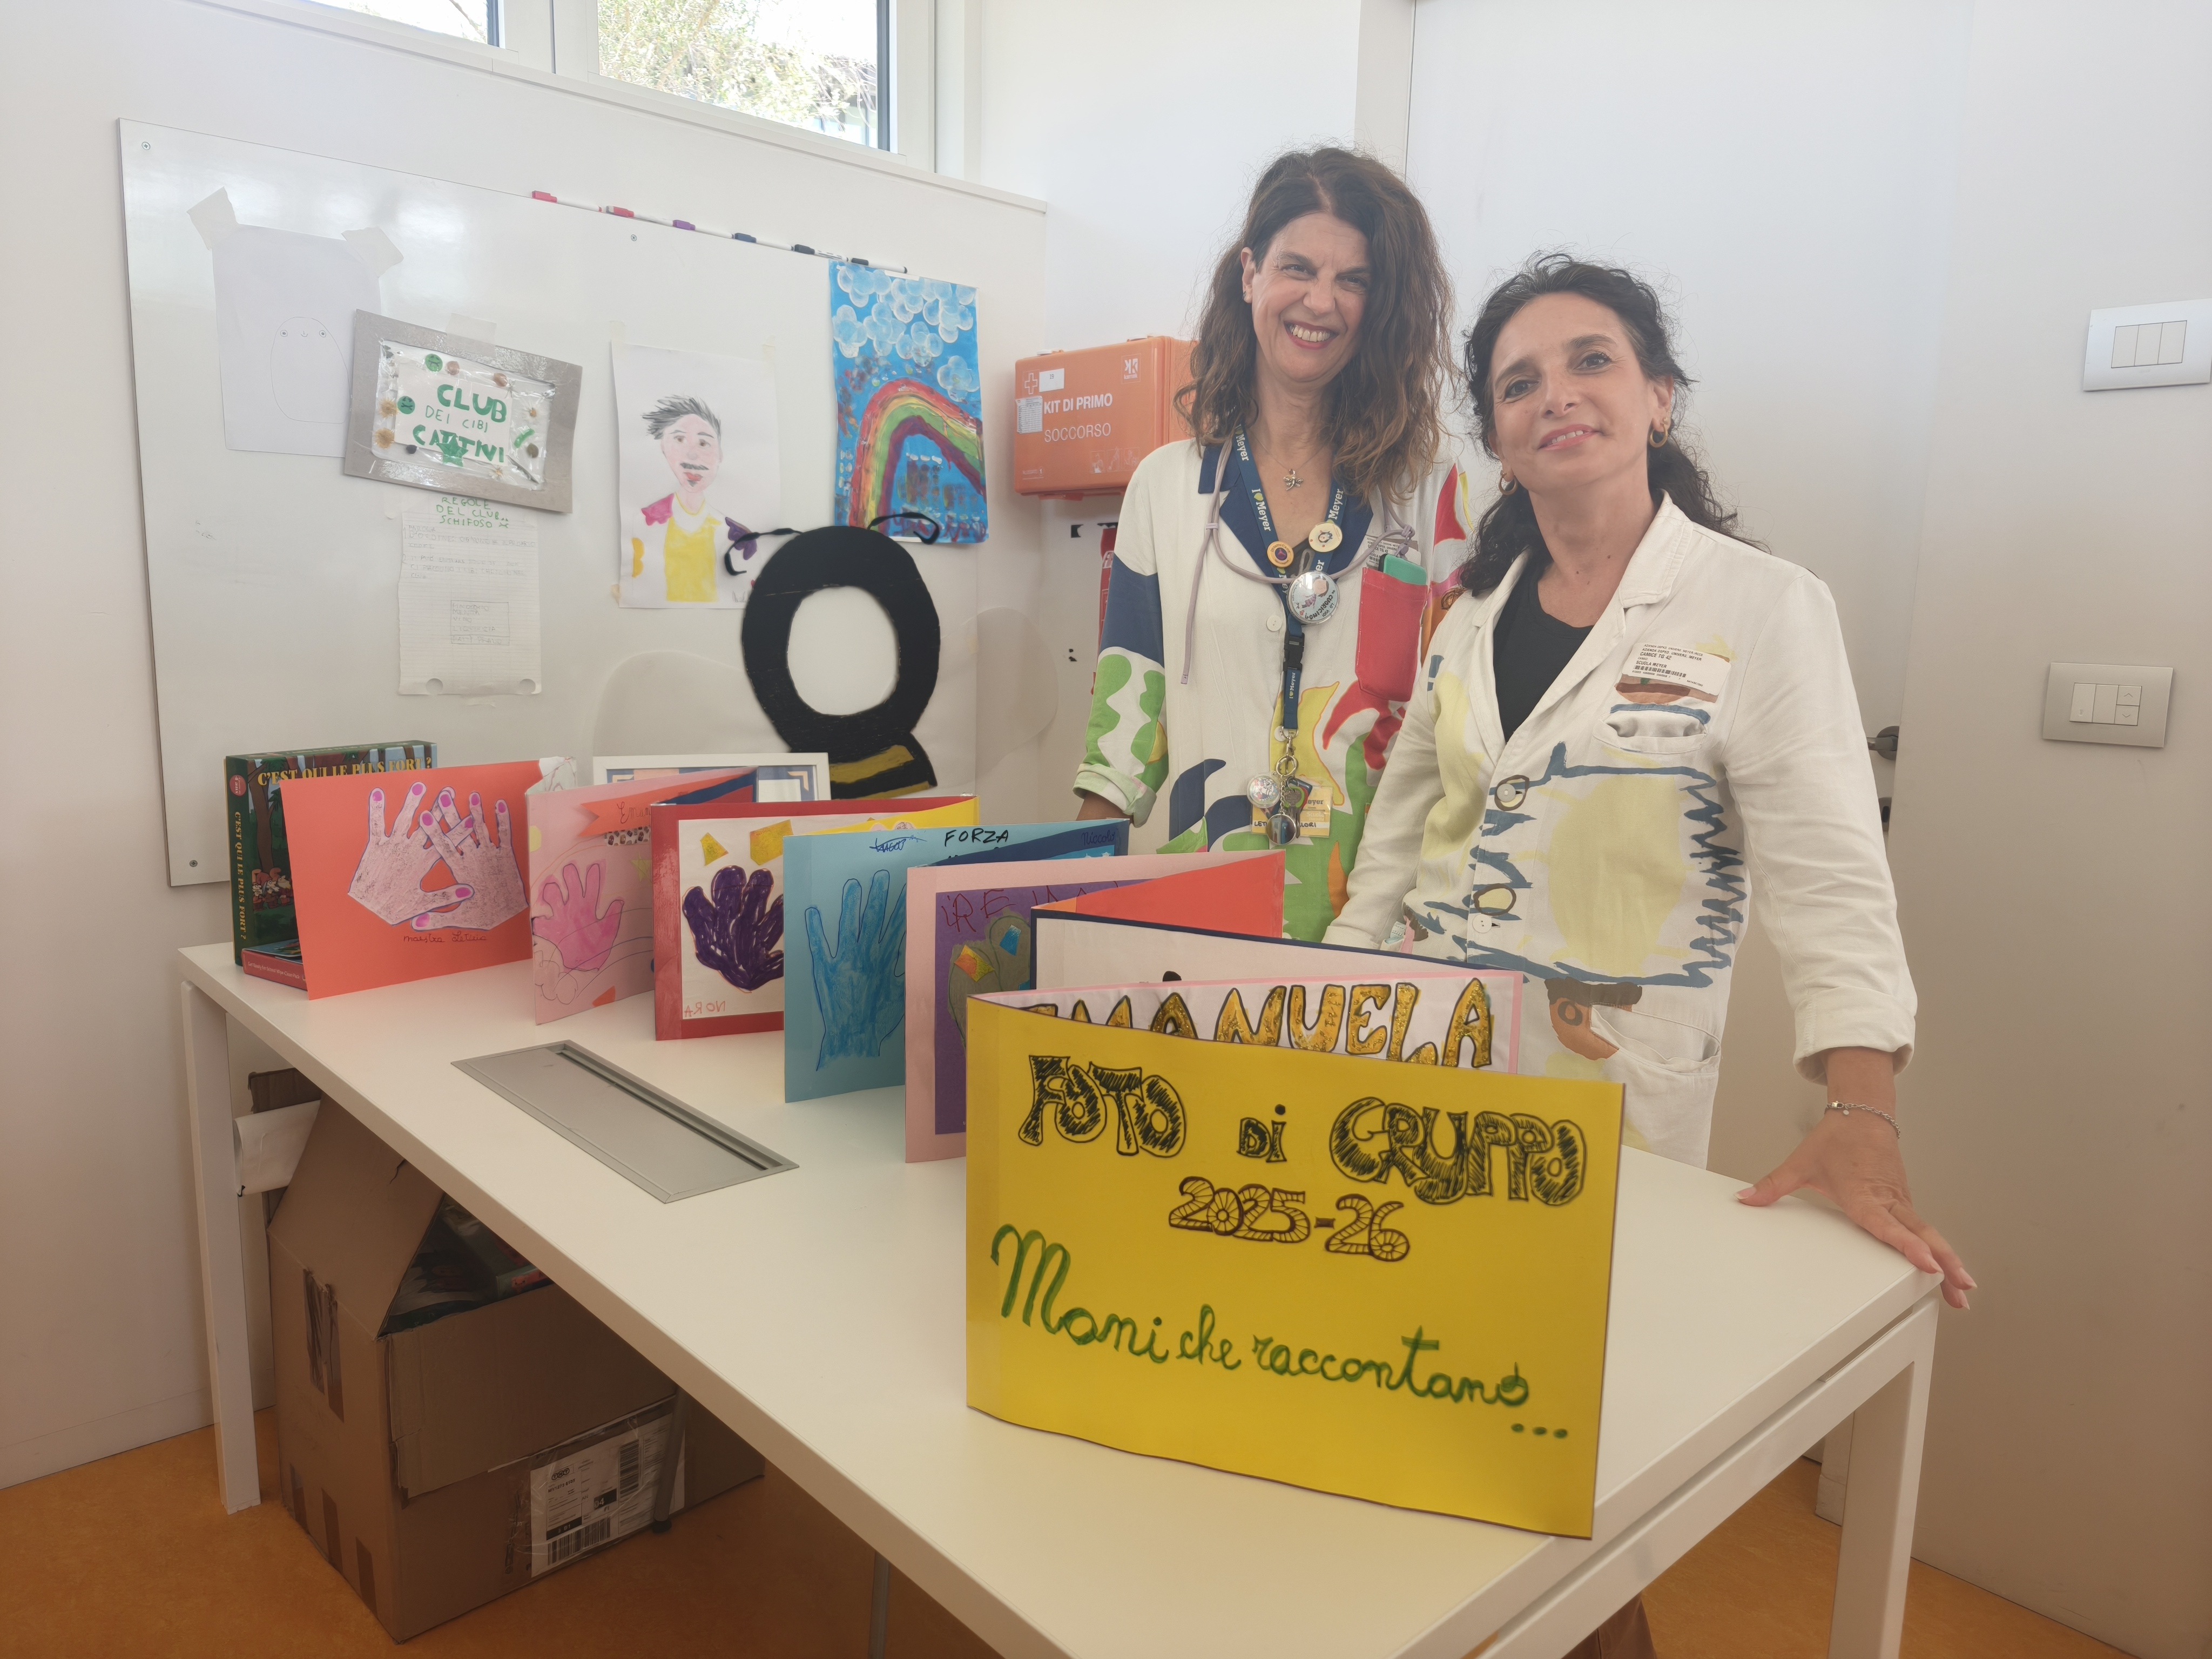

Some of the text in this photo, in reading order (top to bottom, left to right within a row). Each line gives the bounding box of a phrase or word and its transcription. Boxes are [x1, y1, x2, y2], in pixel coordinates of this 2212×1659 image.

[437, 384, 507, 422] CLUB
[1044, 393, 1112, 414] KIT DI PRIMO
[426, 405, 488, 433] DEI CIBI
[1044, 423, 1111, 442] SOCCORSO
[413, 424, 504, 463] CATTIVI
[1236, 433, 1249, 461] Meyer
[436, 504, 499, 520] DEL CLUB
[442, 497, 490, 509] REGOLE
[1256, 501, 1271, 531] Meyer
[1328, 488, 1344, 520] Meyer
[440, 515, 492, 528] SCHIFOSO
[258, 769, 298, 786] C'EST
[352, 761, 385, 775] PLUS
[389, 758, 423, 772] FORT
[945, 828, 1009, 847] FORZA
[237, 864, 243, 875] LE
[1021, 977, 1494, 1068] ANUELA
[1018, 1055, 1186, 1157] FOTO
[1329, 1096, 1586, 1206] GRUPPO
[1168, 1176, 1410, 1262] 2025-26
[1176, 1304, 1241, 1371] che
